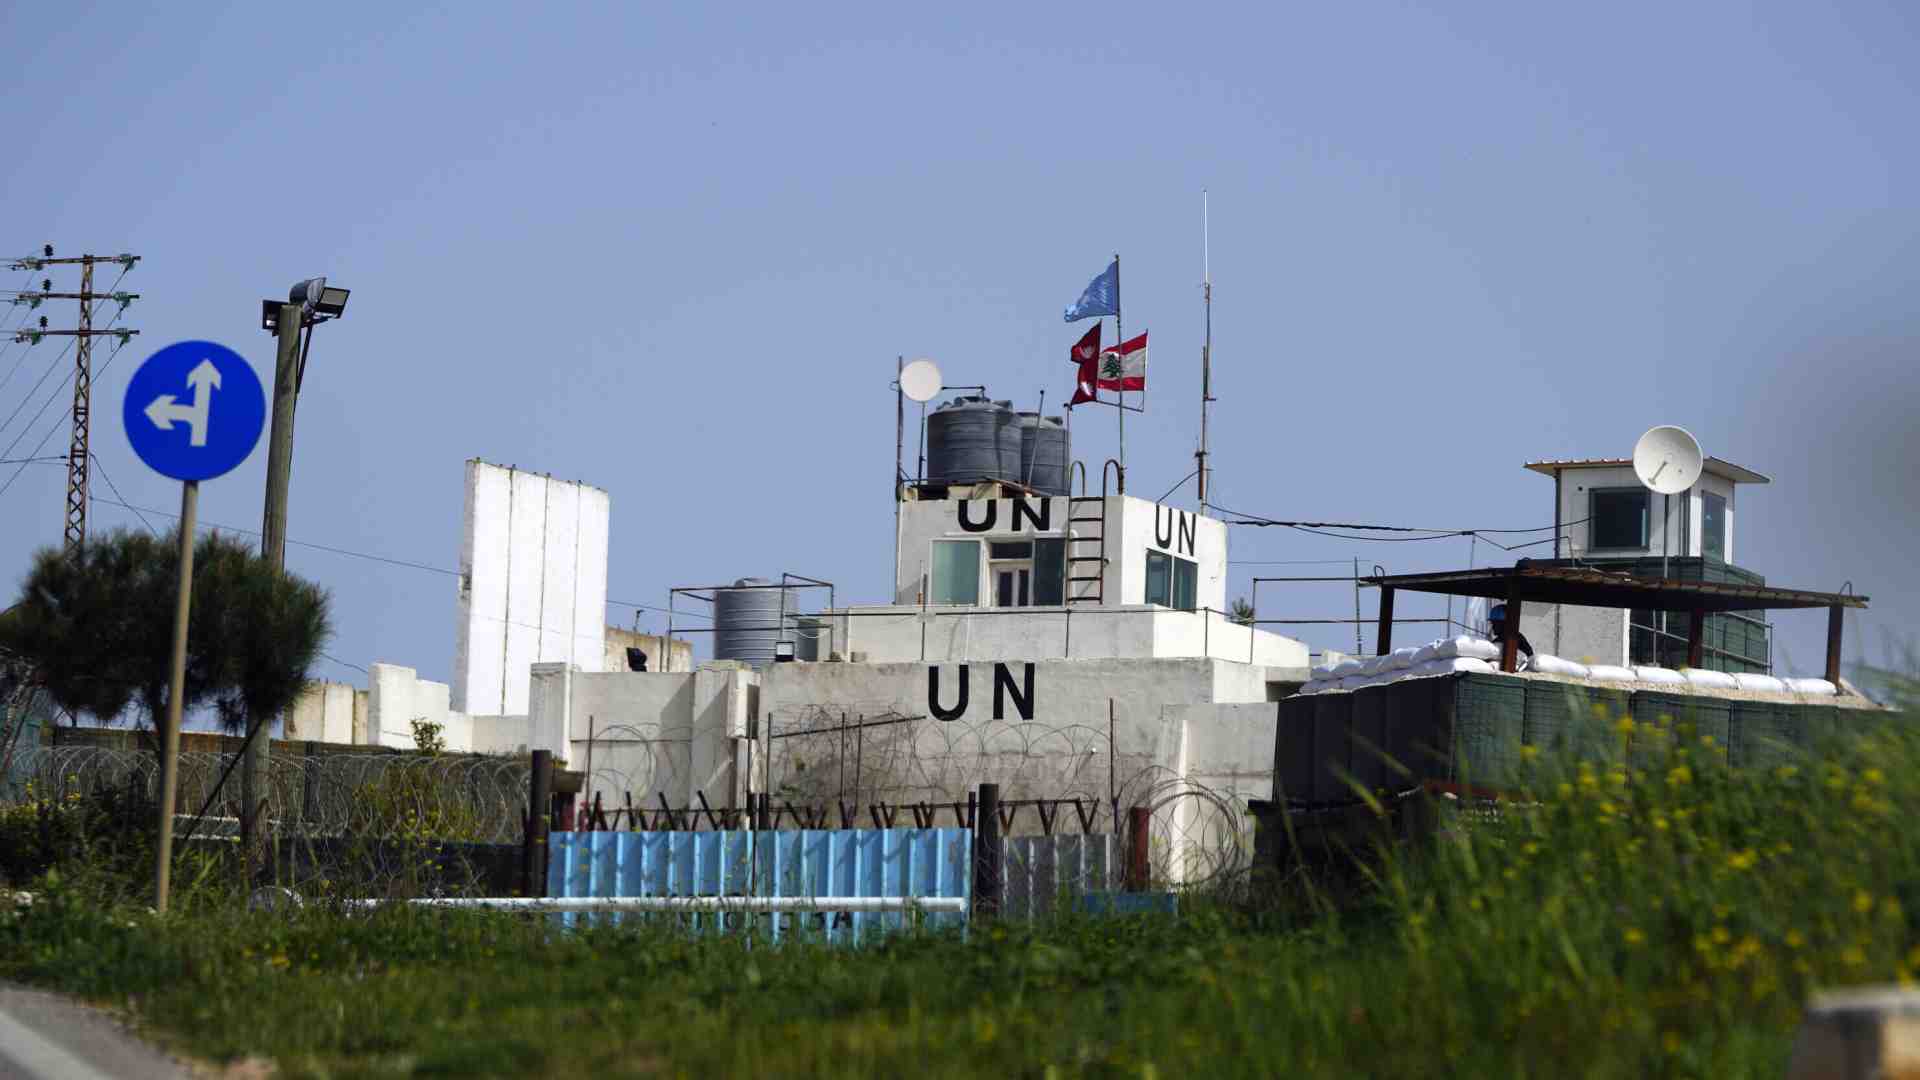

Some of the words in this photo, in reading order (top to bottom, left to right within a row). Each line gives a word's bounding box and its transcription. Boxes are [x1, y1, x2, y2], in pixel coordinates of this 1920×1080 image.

[957, 498, 1051, 532] UN
[1154, 504, 1198, 557] UN
[928, 662, 1035, 722] UN
